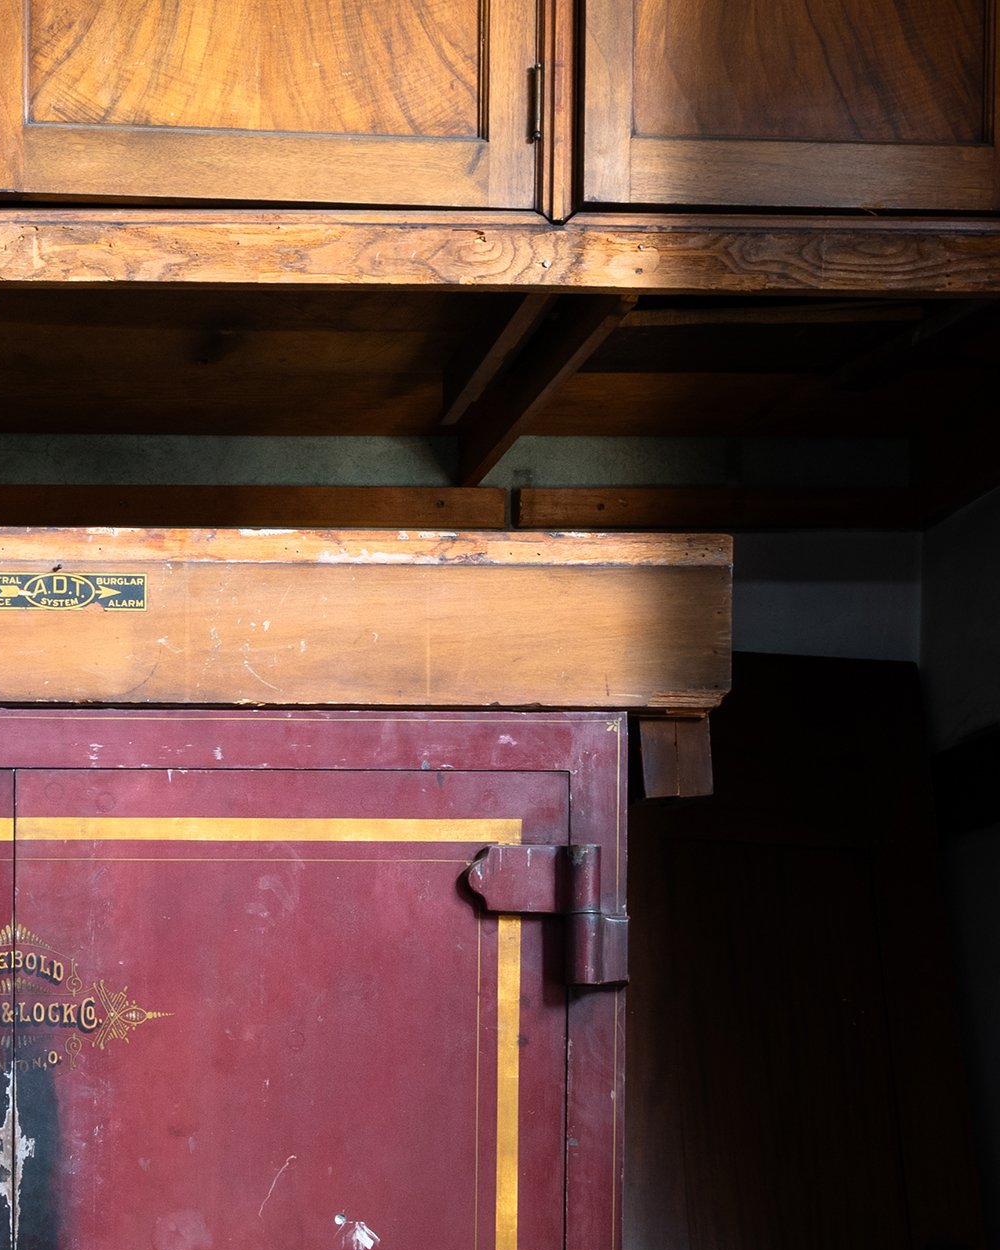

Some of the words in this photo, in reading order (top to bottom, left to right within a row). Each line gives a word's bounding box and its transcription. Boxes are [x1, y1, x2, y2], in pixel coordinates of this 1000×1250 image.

[96, 578, 144, 586] BURGLAR
[33, 576, 85, 598] A.D.T.
[40, 598, 80, 607] SYSTEM
[108, 600, 144, 608] ALARM
[18, 1002, 77, 1024] LOCK
